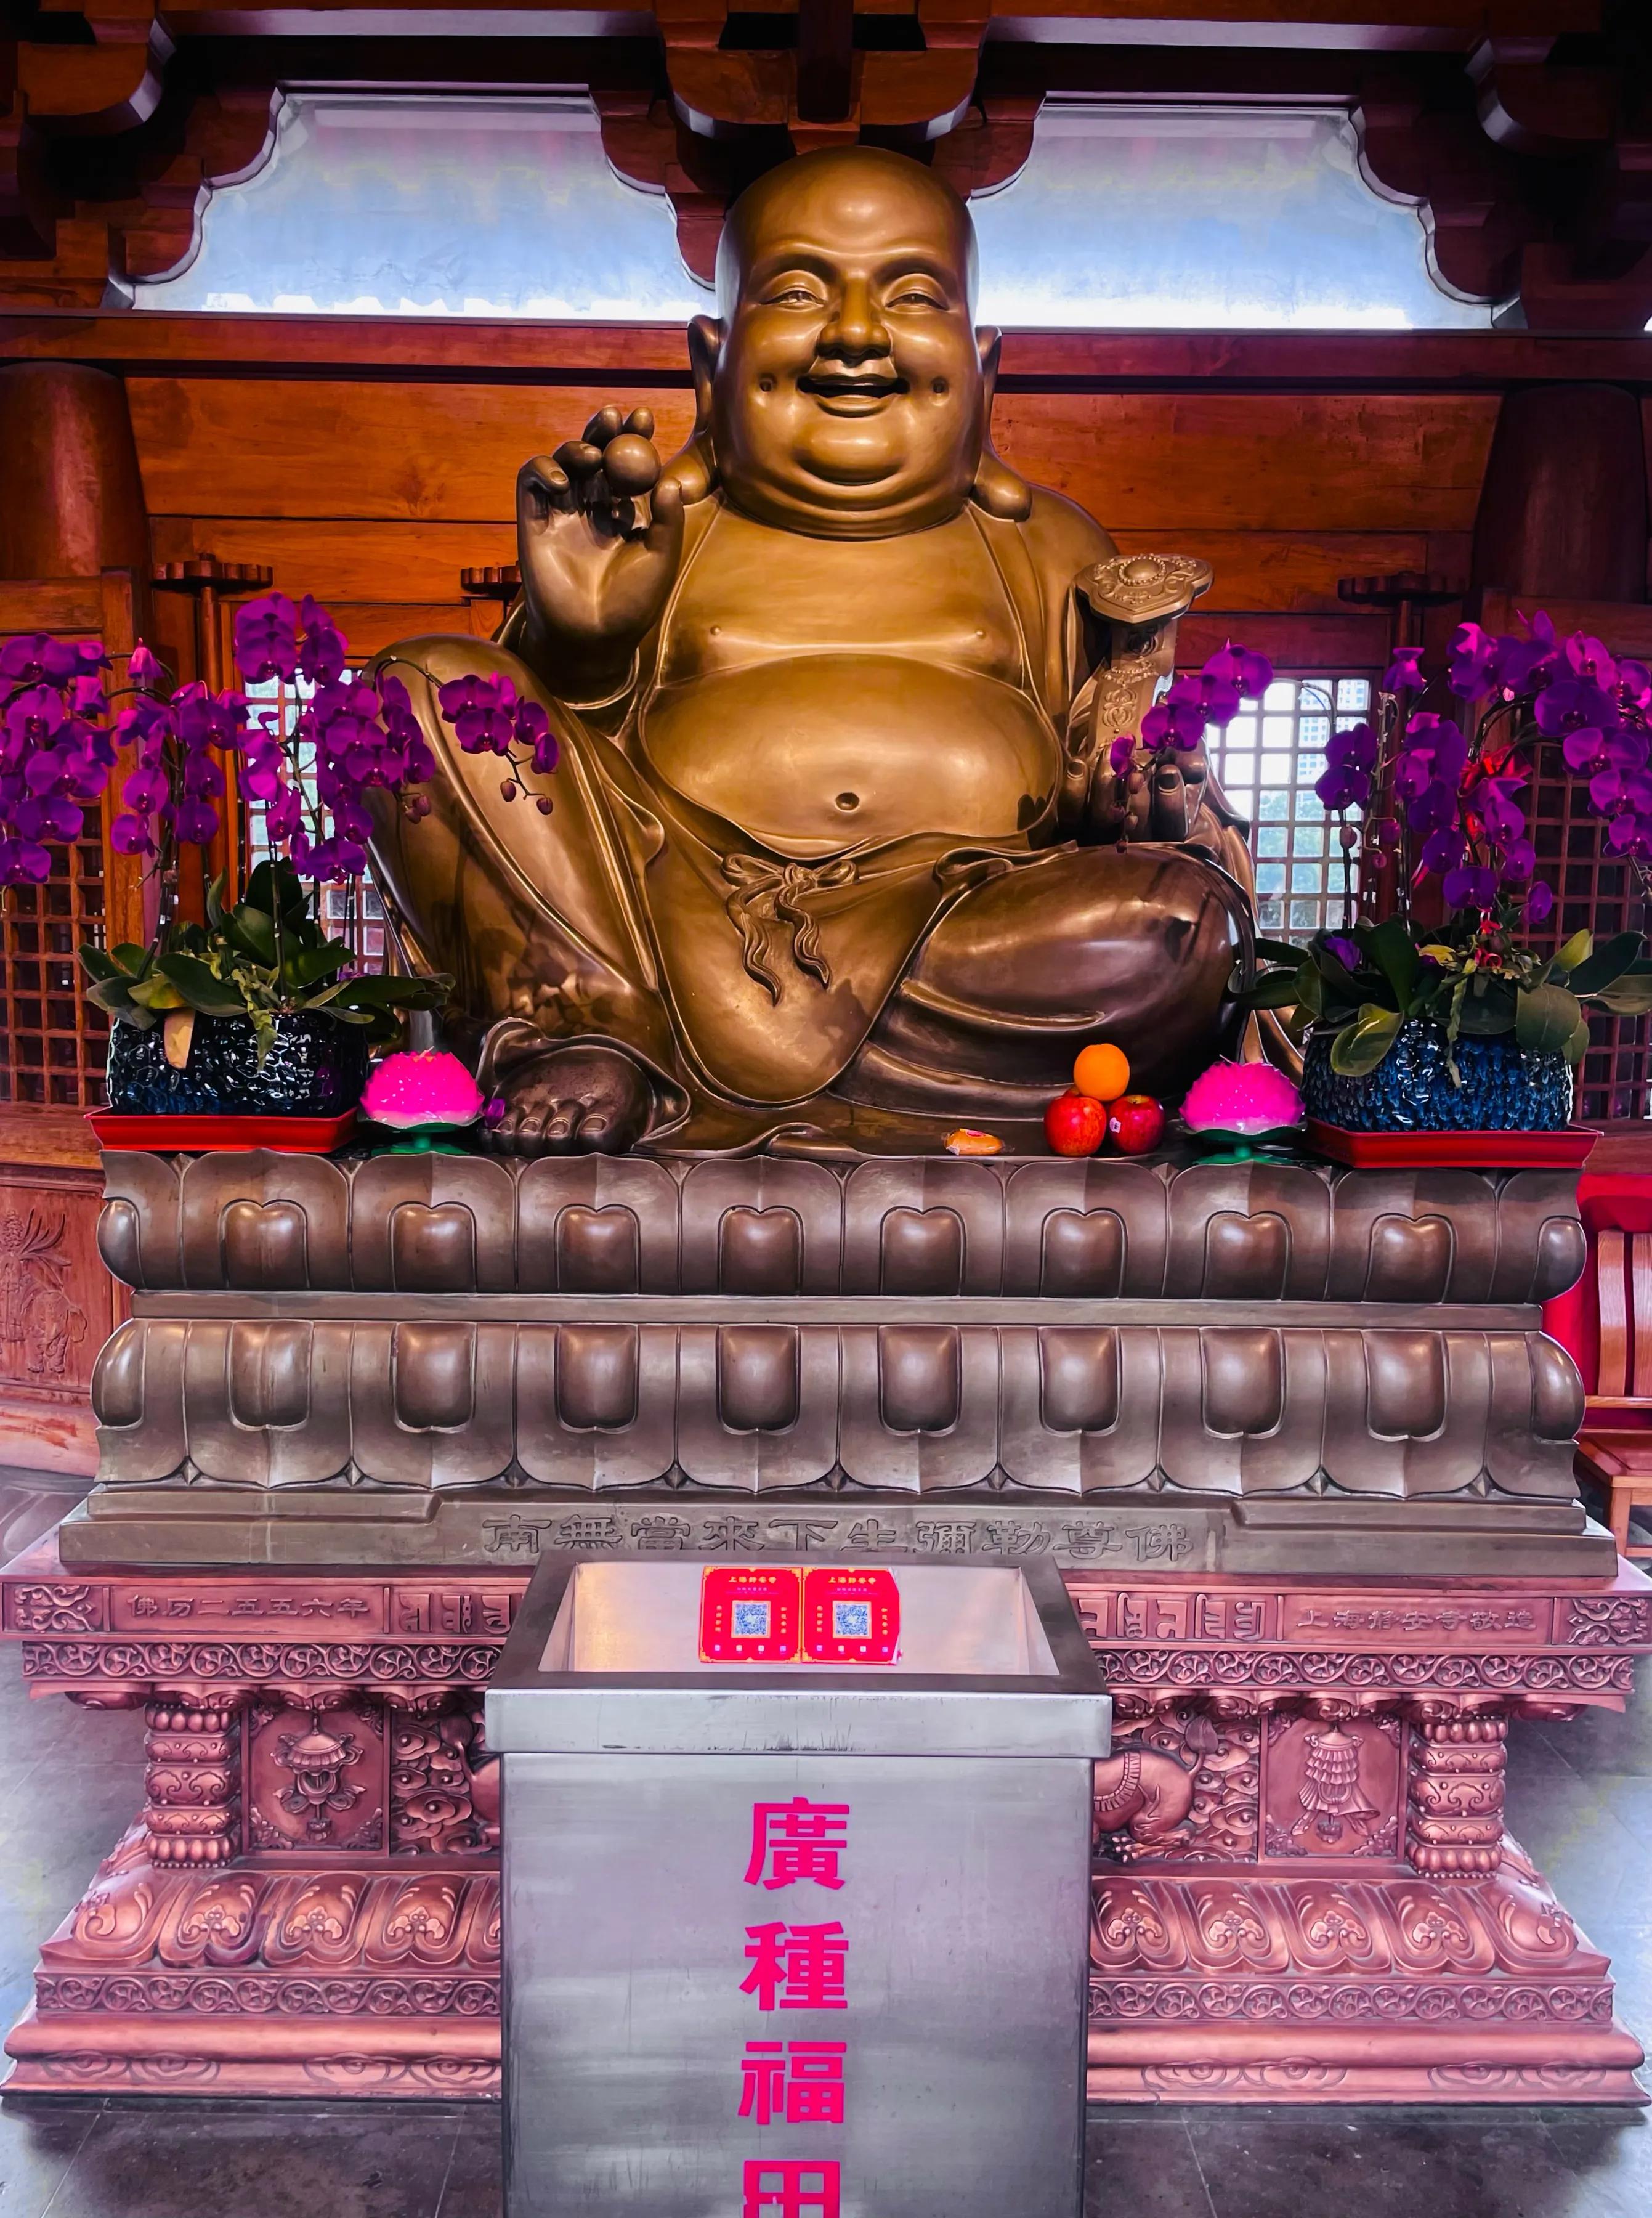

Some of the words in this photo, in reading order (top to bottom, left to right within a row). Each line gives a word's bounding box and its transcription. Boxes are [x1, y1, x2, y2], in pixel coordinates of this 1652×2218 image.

[482, 1514, 1194, 1562] 南無當來下生彌勒尊佛
[127, 1594, 370, 1618] 佛历二五五六年
[738, 1797, 850, 2218] 廣種福田
